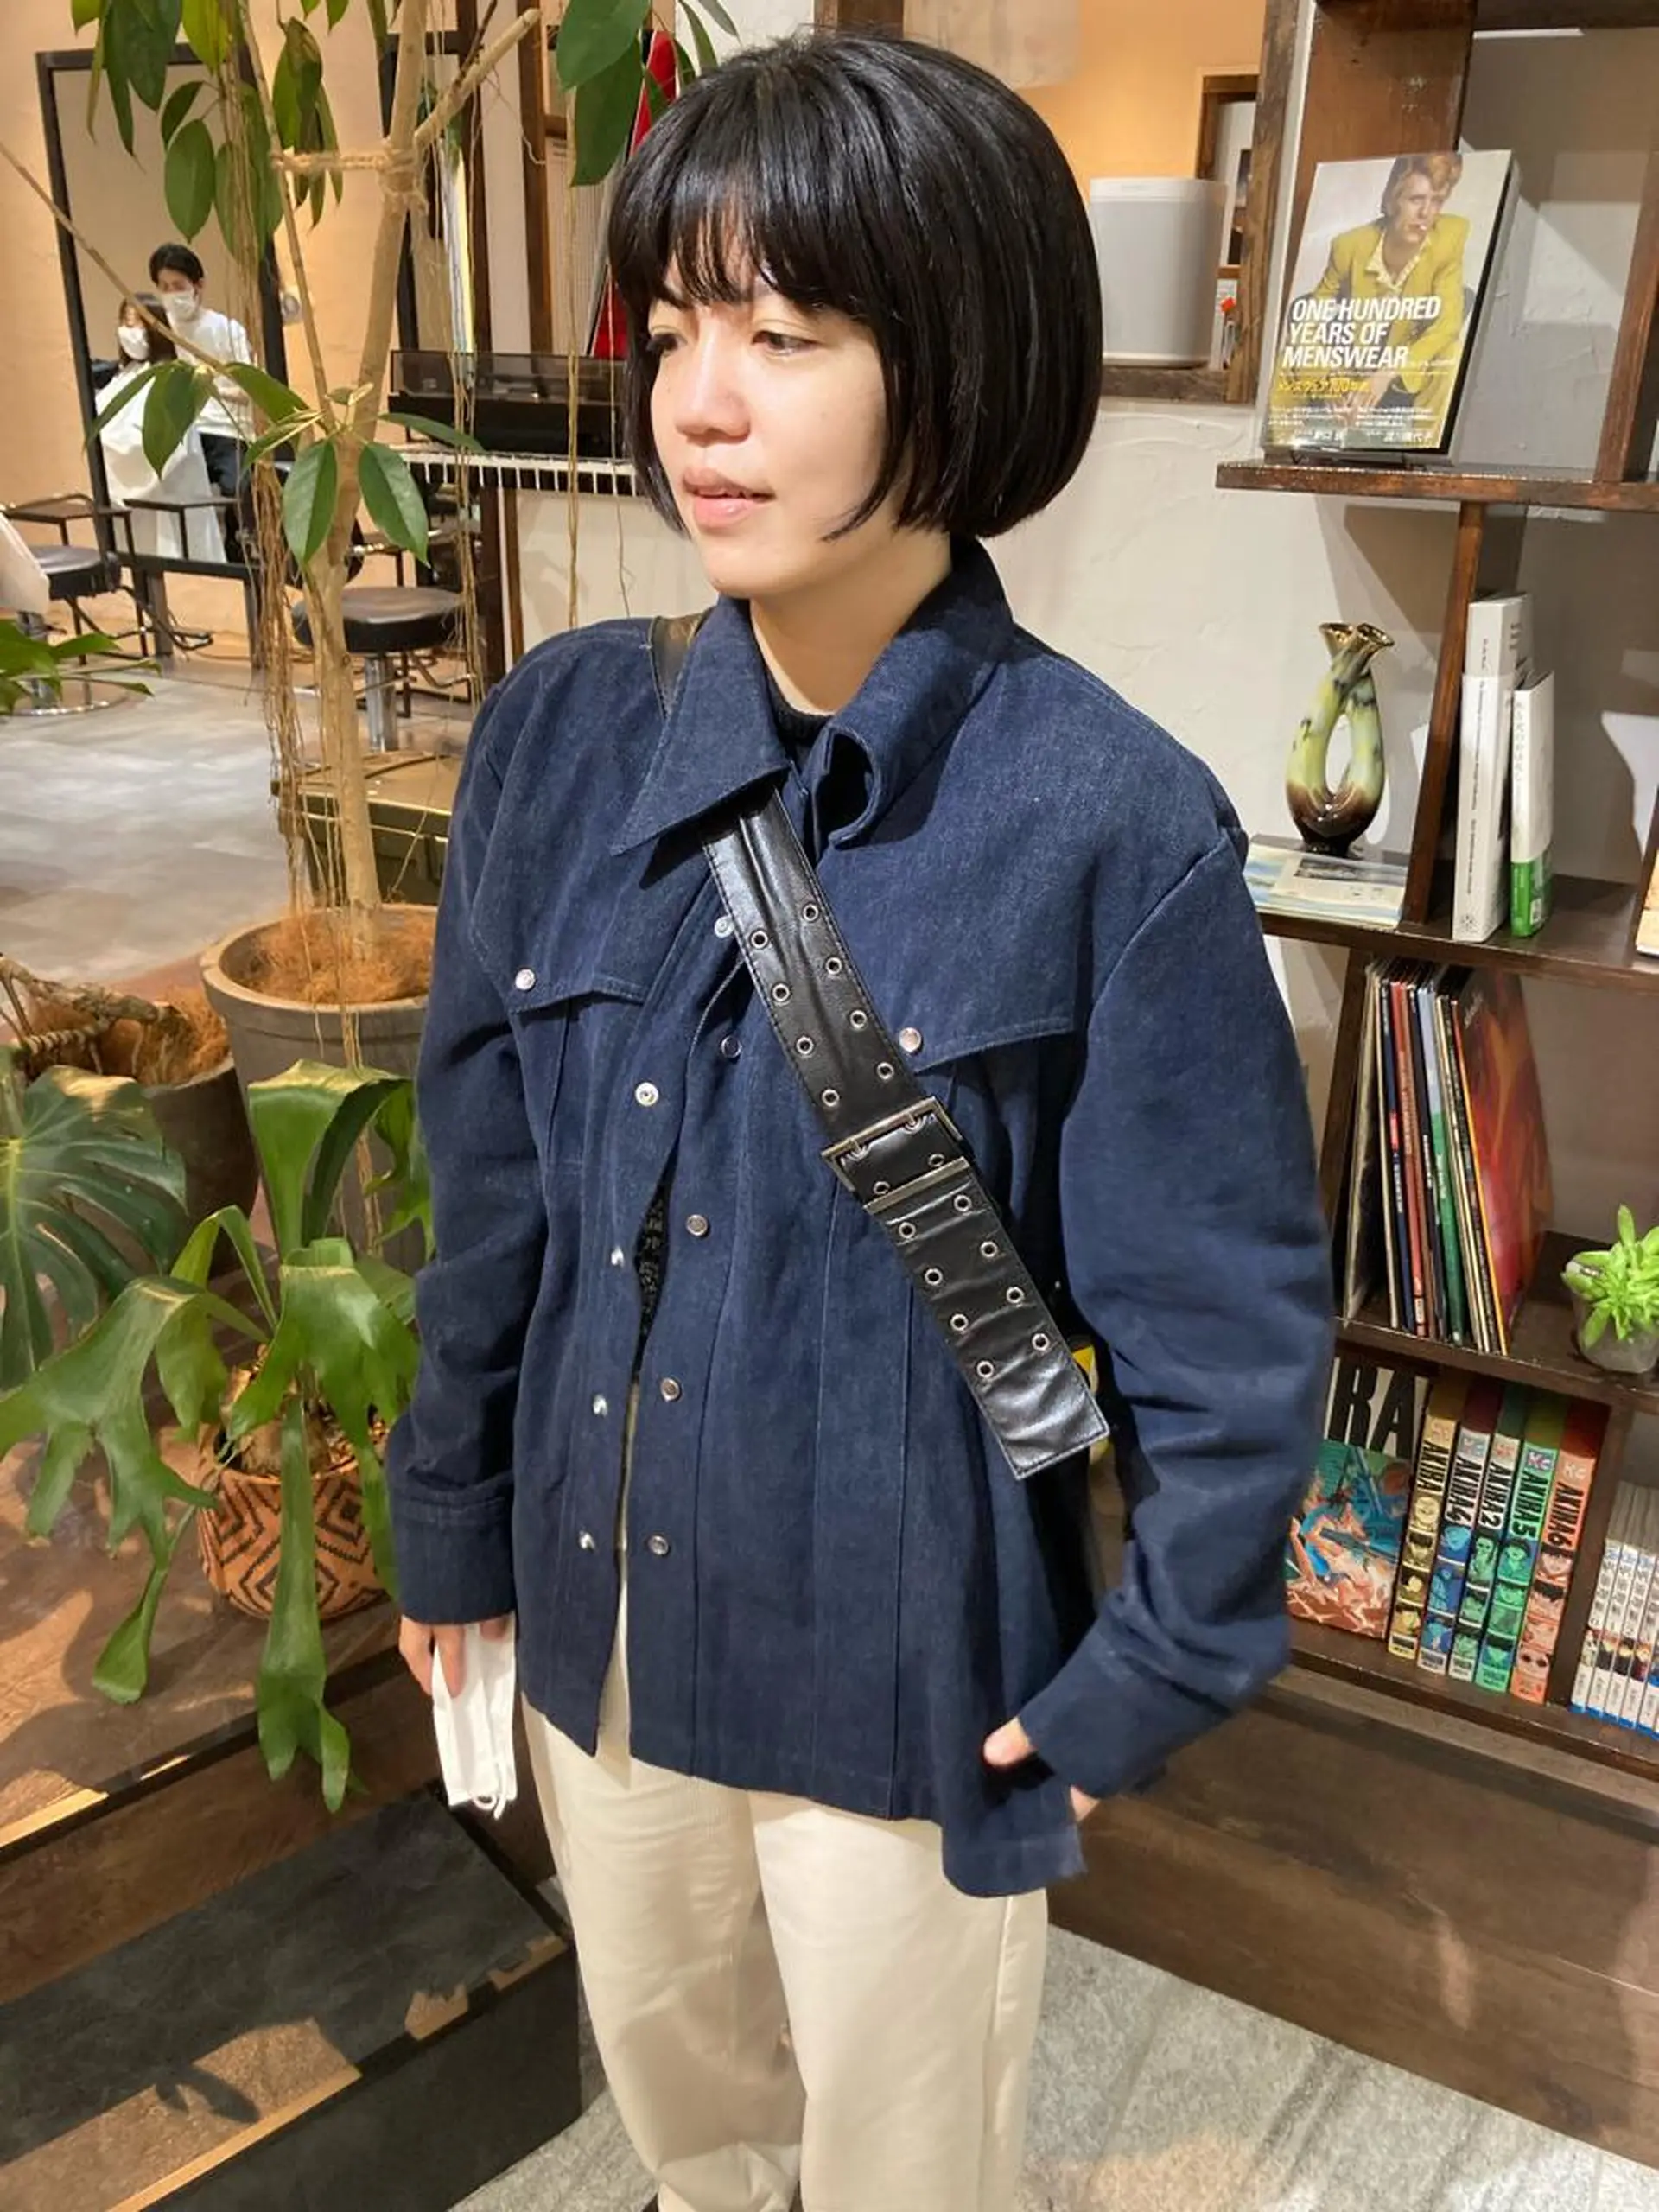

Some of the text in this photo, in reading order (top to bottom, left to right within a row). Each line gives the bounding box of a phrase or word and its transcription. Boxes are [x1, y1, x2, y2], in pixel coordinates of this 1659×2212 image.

[1293, 296, 1442, 321] ONE HUNDRED
[1289, 323, 1388, 345] YEARS OF
[1281, 346, 1408, 368] MENSWEAR
[1416, 1439, 1450, 1495] AKIRA
